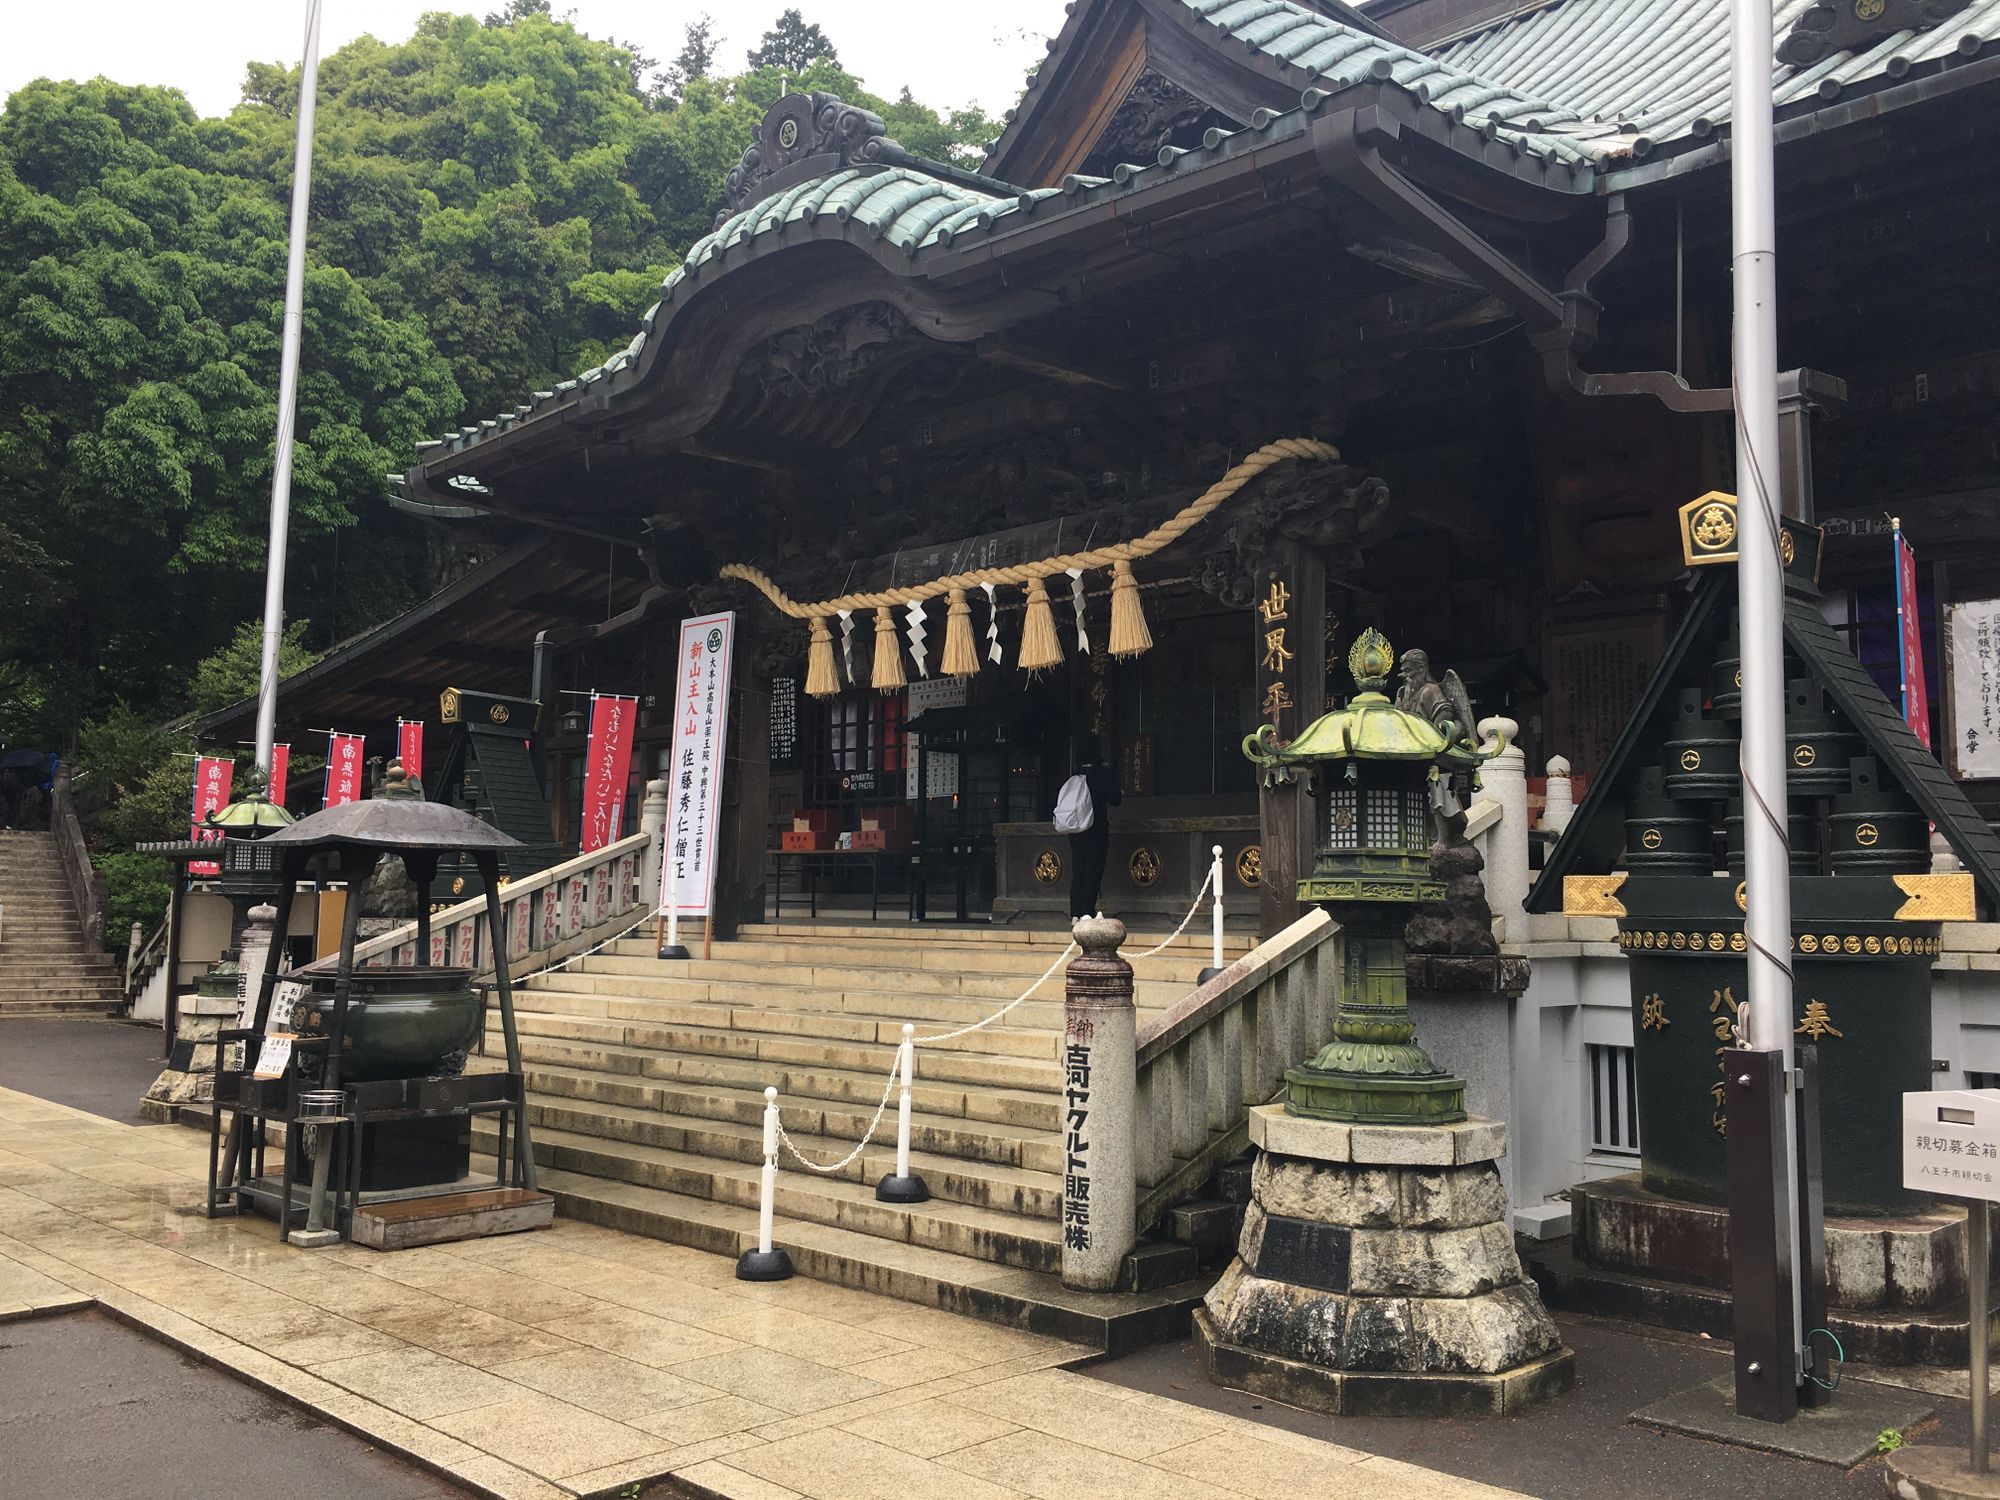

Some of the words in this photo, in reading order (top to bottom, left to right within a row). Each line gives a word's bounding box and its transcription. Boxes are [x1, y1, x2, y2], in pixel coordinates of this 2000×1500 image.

[1257, 580, 1295, 745] 世界平
[685, 641, 703, 736] 新山主入山
[850, 782, 857, 791] NO
[858, 781, 875, 790] PHOTO
[571, 879, 583, 930] ヤクルト
[597, 869, 608, 919] ヤクルト
[622, 859, 634, 908] ヤクルト
[517, 902, 529, 953] ヤクルト
[544, 891, 555, 942] ヤクルト
[1642, 993, 1671, 1031] 納
[1793, 998, 1844, 1042] 奉
[1916, 1135, 1997, 1159] 親切募金箱
[1921, 1165, 1992, 1183] 八王子市親切会
